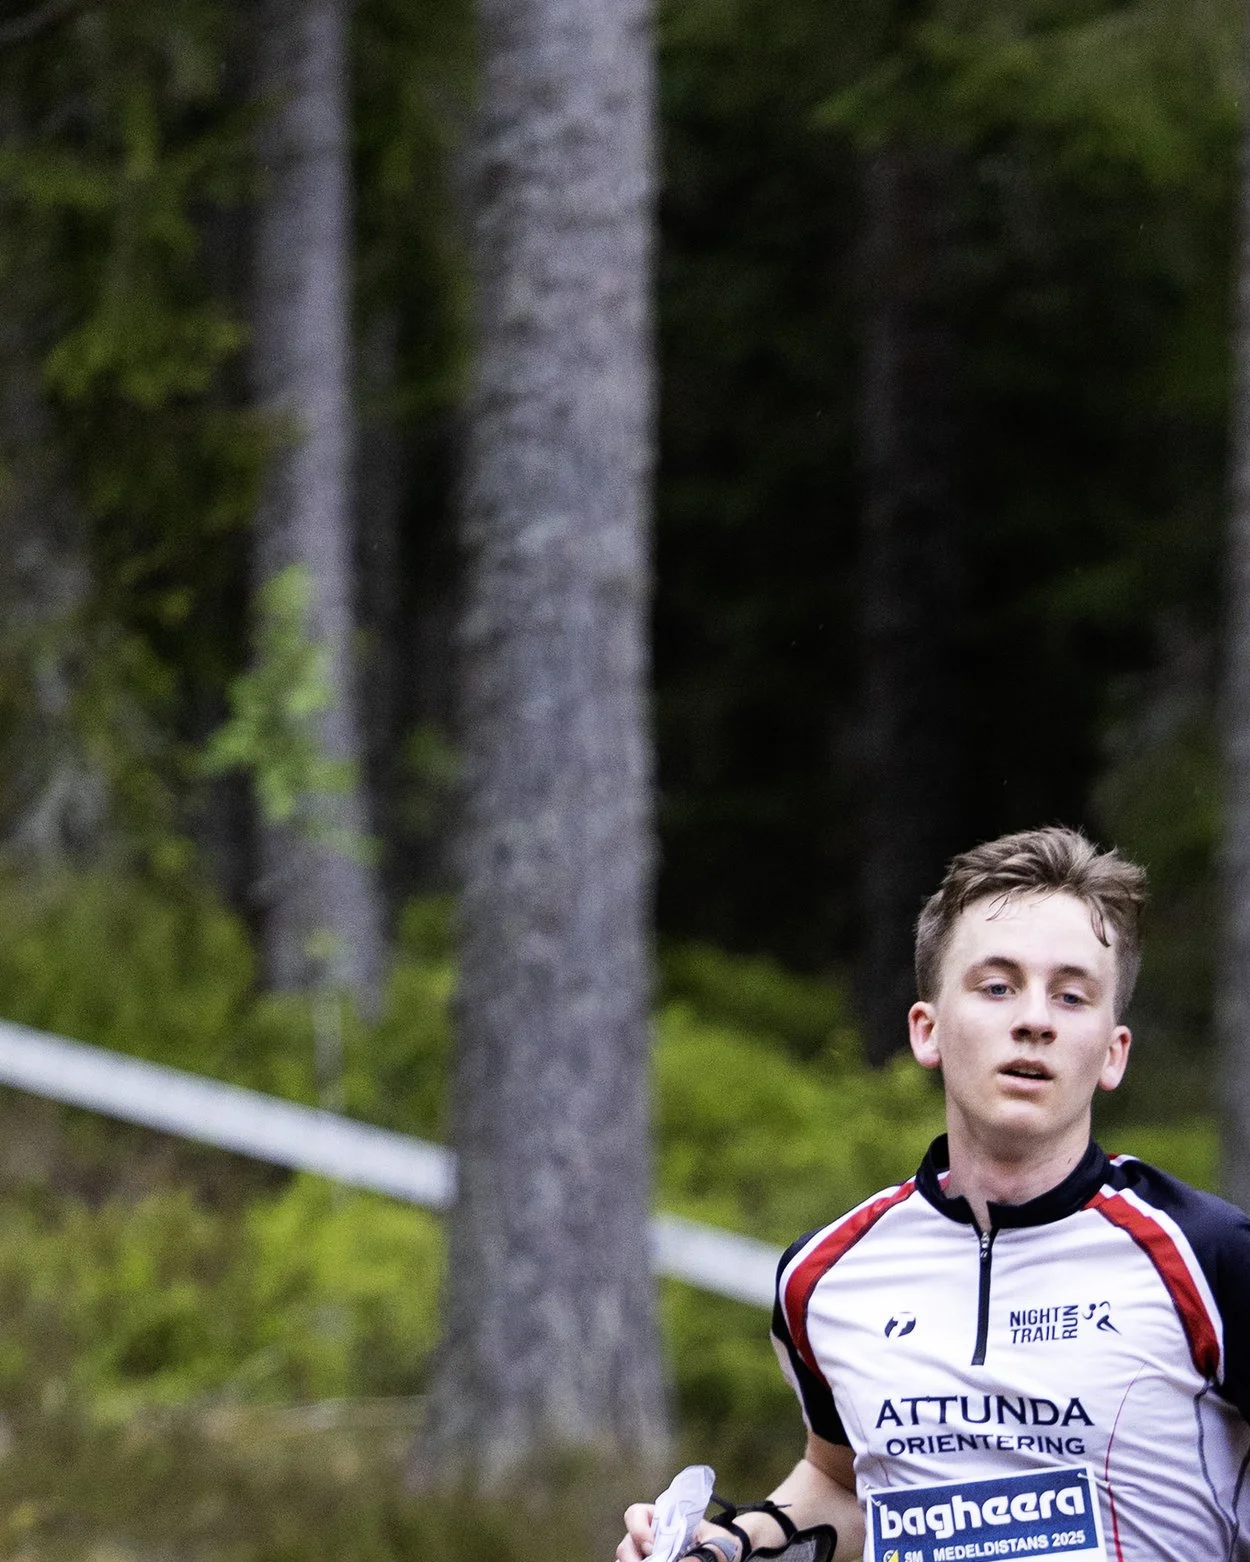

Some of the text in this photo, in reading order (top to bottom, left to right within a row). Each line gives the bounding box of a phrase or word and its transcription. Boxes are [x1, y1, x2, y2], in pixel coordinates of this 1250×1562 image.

[1010, 1306, 1061, 1328] NIGHT
[1062, 1304, 1079, 1339] RUN
[1011, 1325, 1060, 1344] TRAIL
[875, 1395, 1095, 1429] ATTUNDA
[886, 1434, 1086, 1456] ORIENTERING
[880, 1486, 1086, 1539] bagheera
[933, 1534, 1049, 1562] MEDELDISTANS
[1052, 1530, 1086, 1547] 2025
